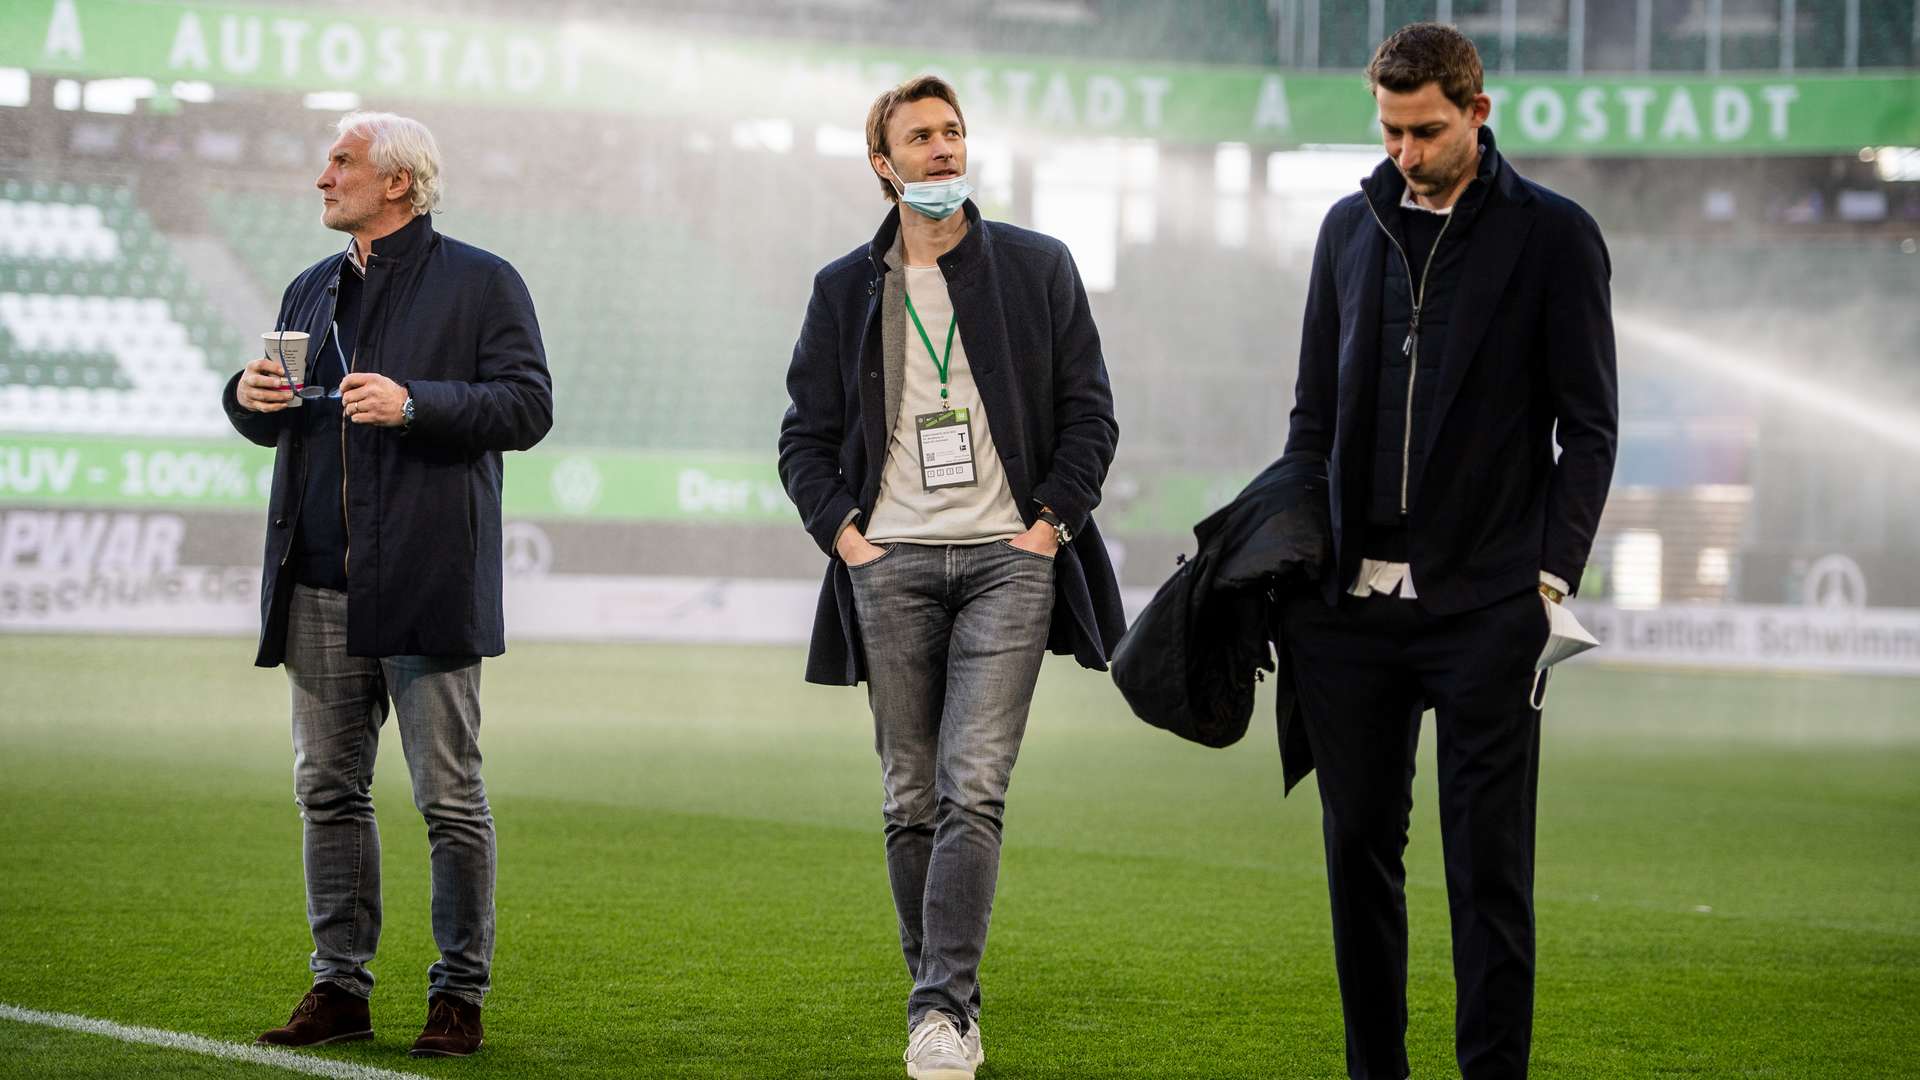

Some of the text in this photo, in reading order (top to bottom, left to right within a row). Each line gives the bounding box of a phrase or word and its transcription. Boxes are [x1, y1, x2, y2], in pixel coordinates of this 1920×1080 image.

[168, 12, 583, 94] AUTOSTADT
[1252, 74, 1293, 137] A
[958, 432, 966, 443] T
[120, 450, 249, 499] 100%
